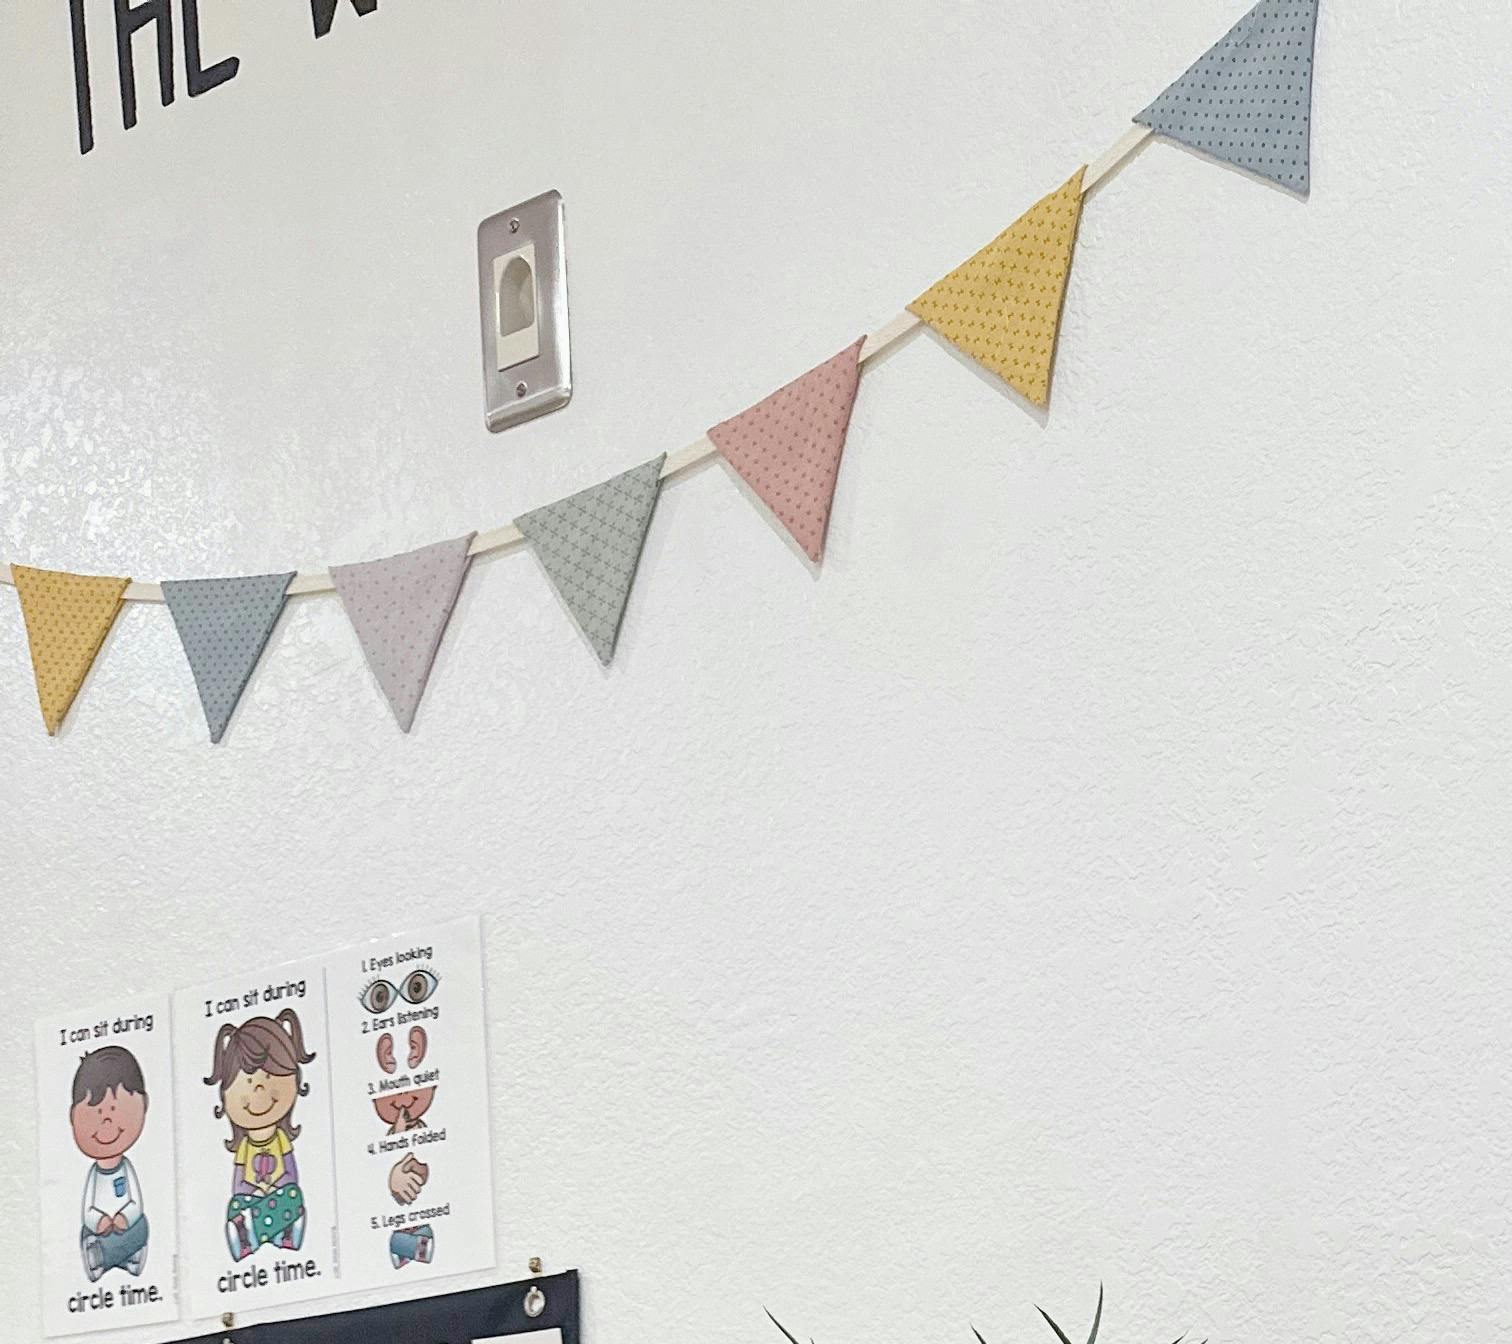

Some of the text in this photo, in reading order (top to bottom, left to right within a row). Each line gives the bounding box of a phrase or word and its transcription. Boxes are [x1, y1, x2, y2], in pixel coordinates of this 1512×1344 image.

[369, 956, 394, 972] Eyes
[395, 946, 433, 965] looking
[205, 980, 306, 1017] I can sit during
[60, 1014, 154, 1046] I can sit during
[372, 1016, 395, 1031] Ears
[397, 1006, 440, 1025] listening
[379, 1074, 411, 1092] Mouth
[413, 1068, 440, 1086] quiet
[379, 1136, 410, 1153] Hands
[381, 1213, 406, 1228] Legs
[408, 1202, 450, 1222] crossed
[217, 1259, 322, 1293] circle time.
[67, 1284, 163, 1313] circle time.
